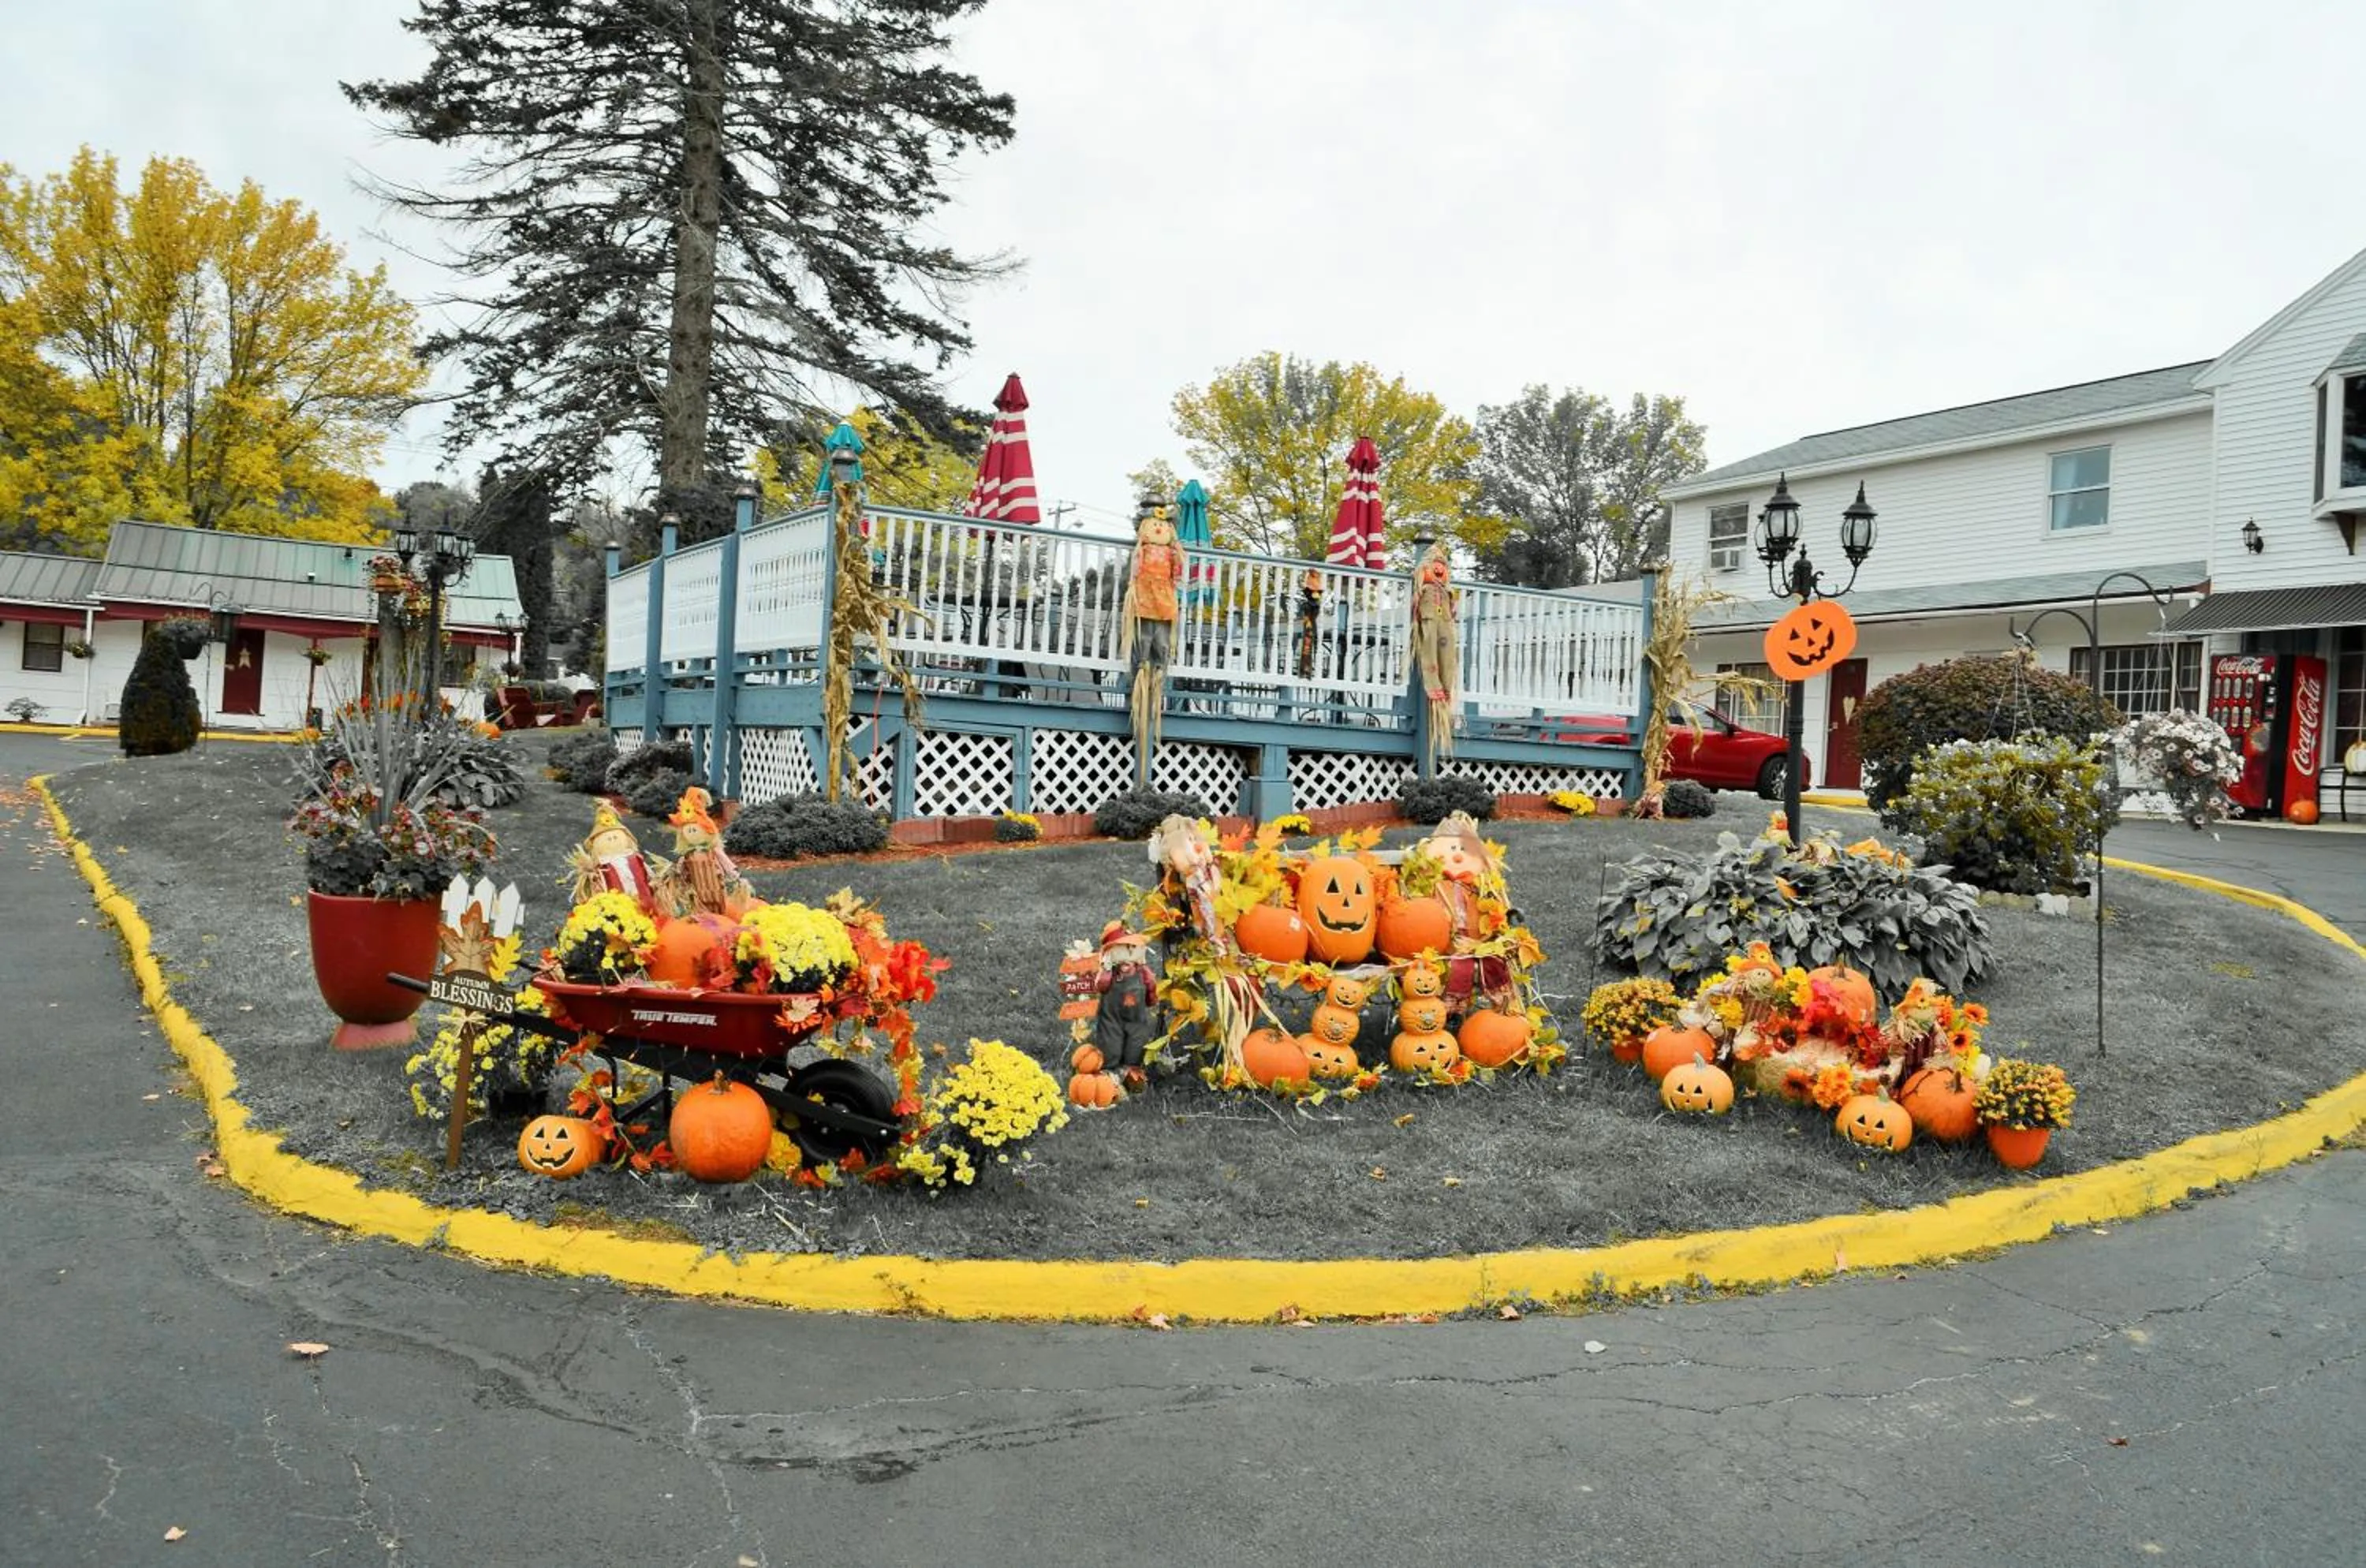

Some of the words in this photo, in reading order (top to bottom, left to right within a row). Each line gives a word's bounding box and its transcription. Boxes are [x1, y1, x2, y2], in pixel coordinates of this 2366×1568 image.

[2292, 670, 2320, 775] Coca-Cola
[453, 976, 490, 990] AUTUMN
[1065, 981, 1092, 993] PATCH
[430, 980, 513, 1014] BLESSINGS
[631, 1010, 664, 1021] TRUE
